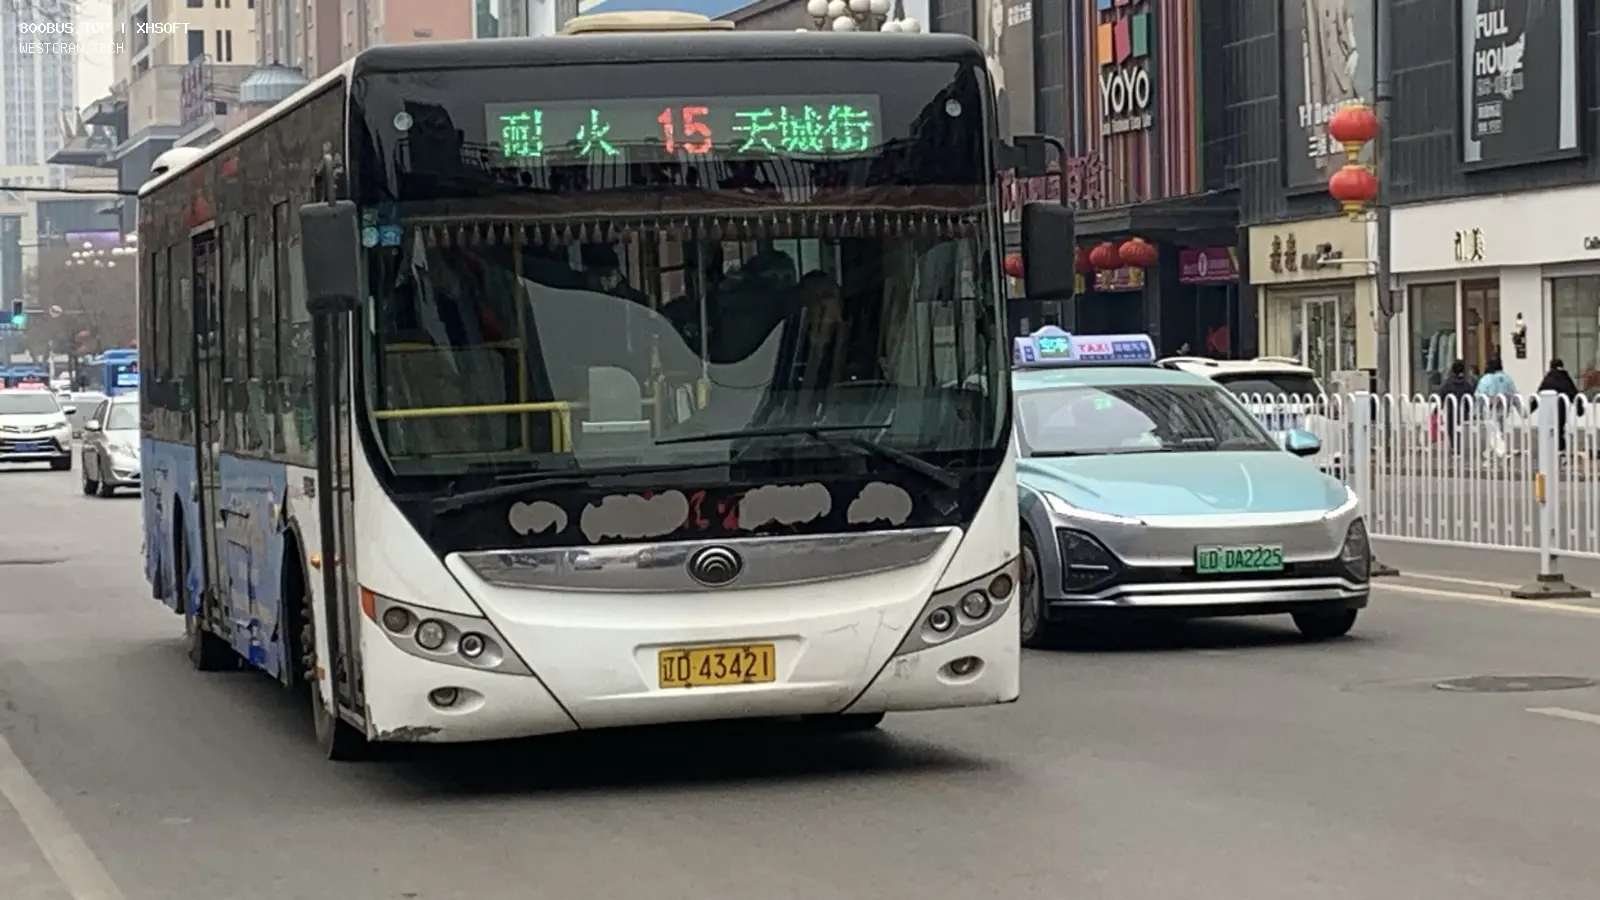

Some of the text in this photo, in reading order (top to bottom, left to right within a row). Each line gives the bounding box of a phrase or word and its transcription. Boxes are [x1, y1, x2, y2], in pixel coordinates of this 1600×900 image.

[1476, 9, 1508, 39] FULL
[1099, 65, 1150, 116] YOYO
[656, 104, 713, 154] 15
[1077, 343, 1110, 353] TAXI
